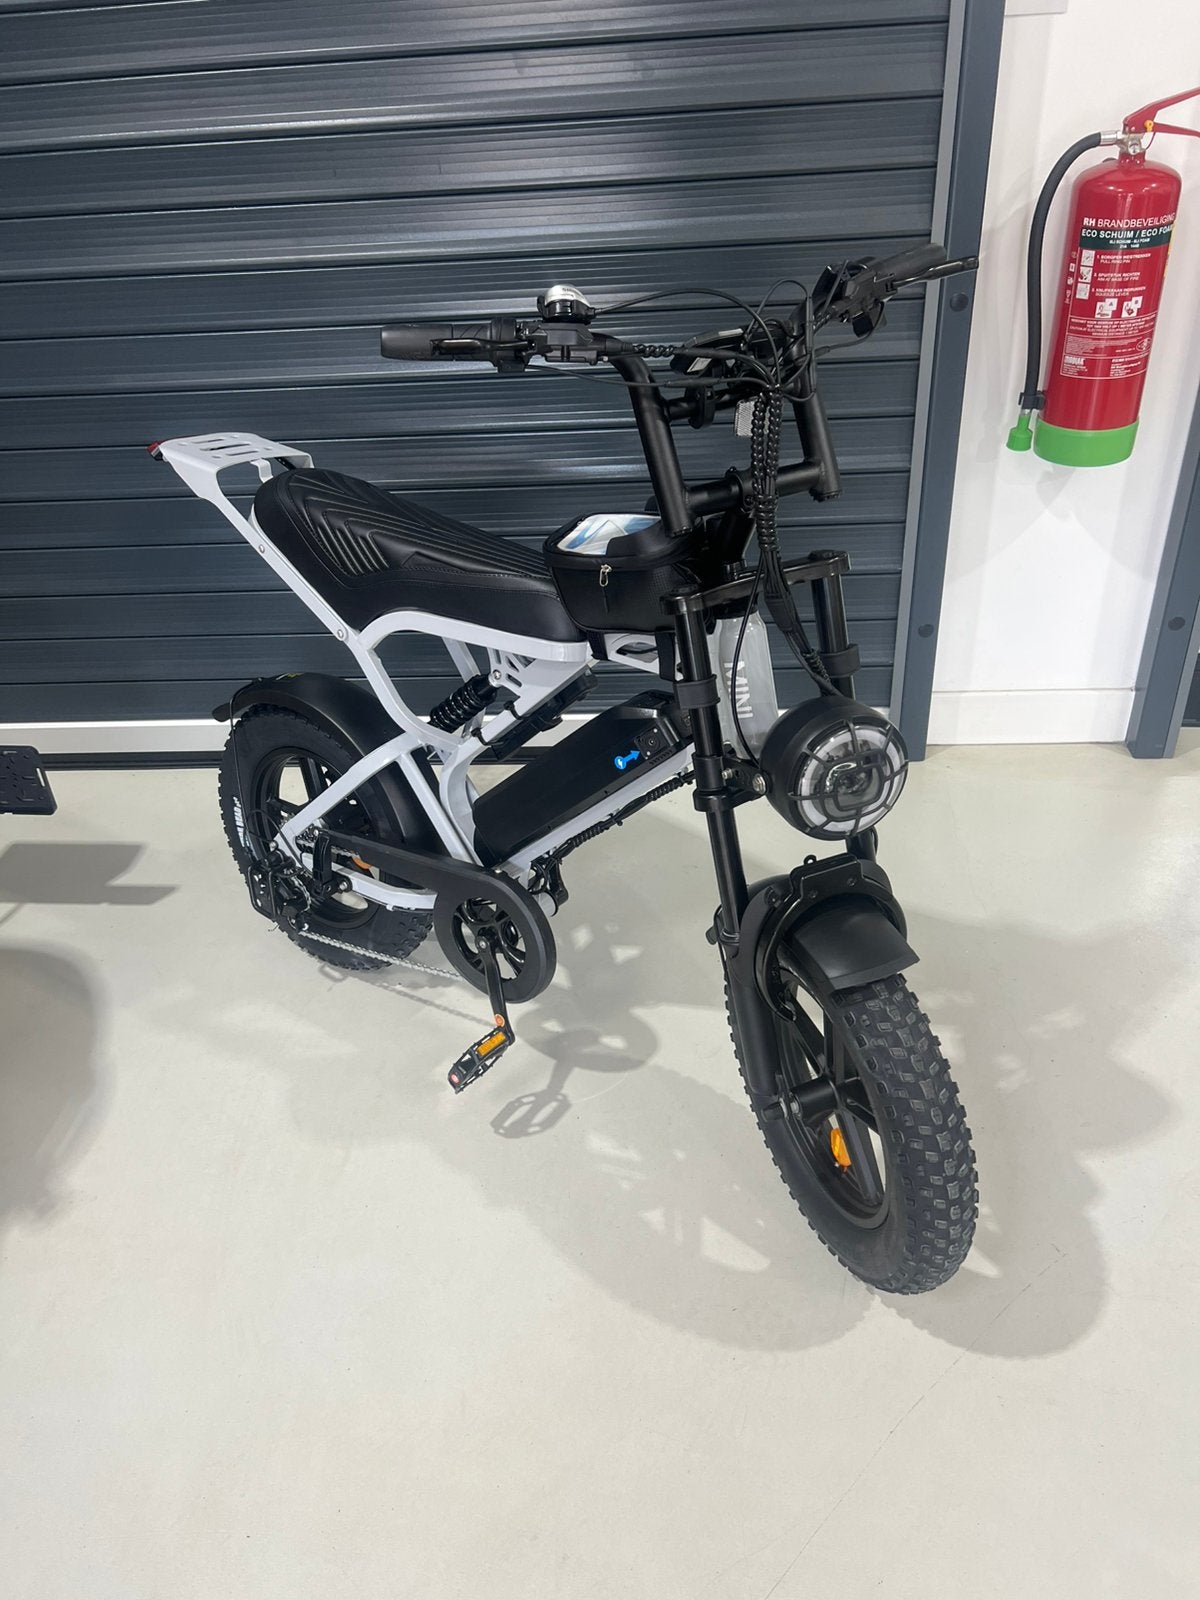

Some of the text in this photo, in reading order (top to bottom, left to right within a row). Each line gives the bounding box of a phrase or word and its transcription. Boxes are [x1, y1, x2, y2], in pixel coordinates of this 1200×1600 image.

[1083, 217, 1096, 227] RH
[1081, 228, 1098, 238] ECO
[1099, 230, 1134, 239] SCHUIM
[1135, 229, 1140, 238] /
[1141, 227, 1158, 238] ECO
